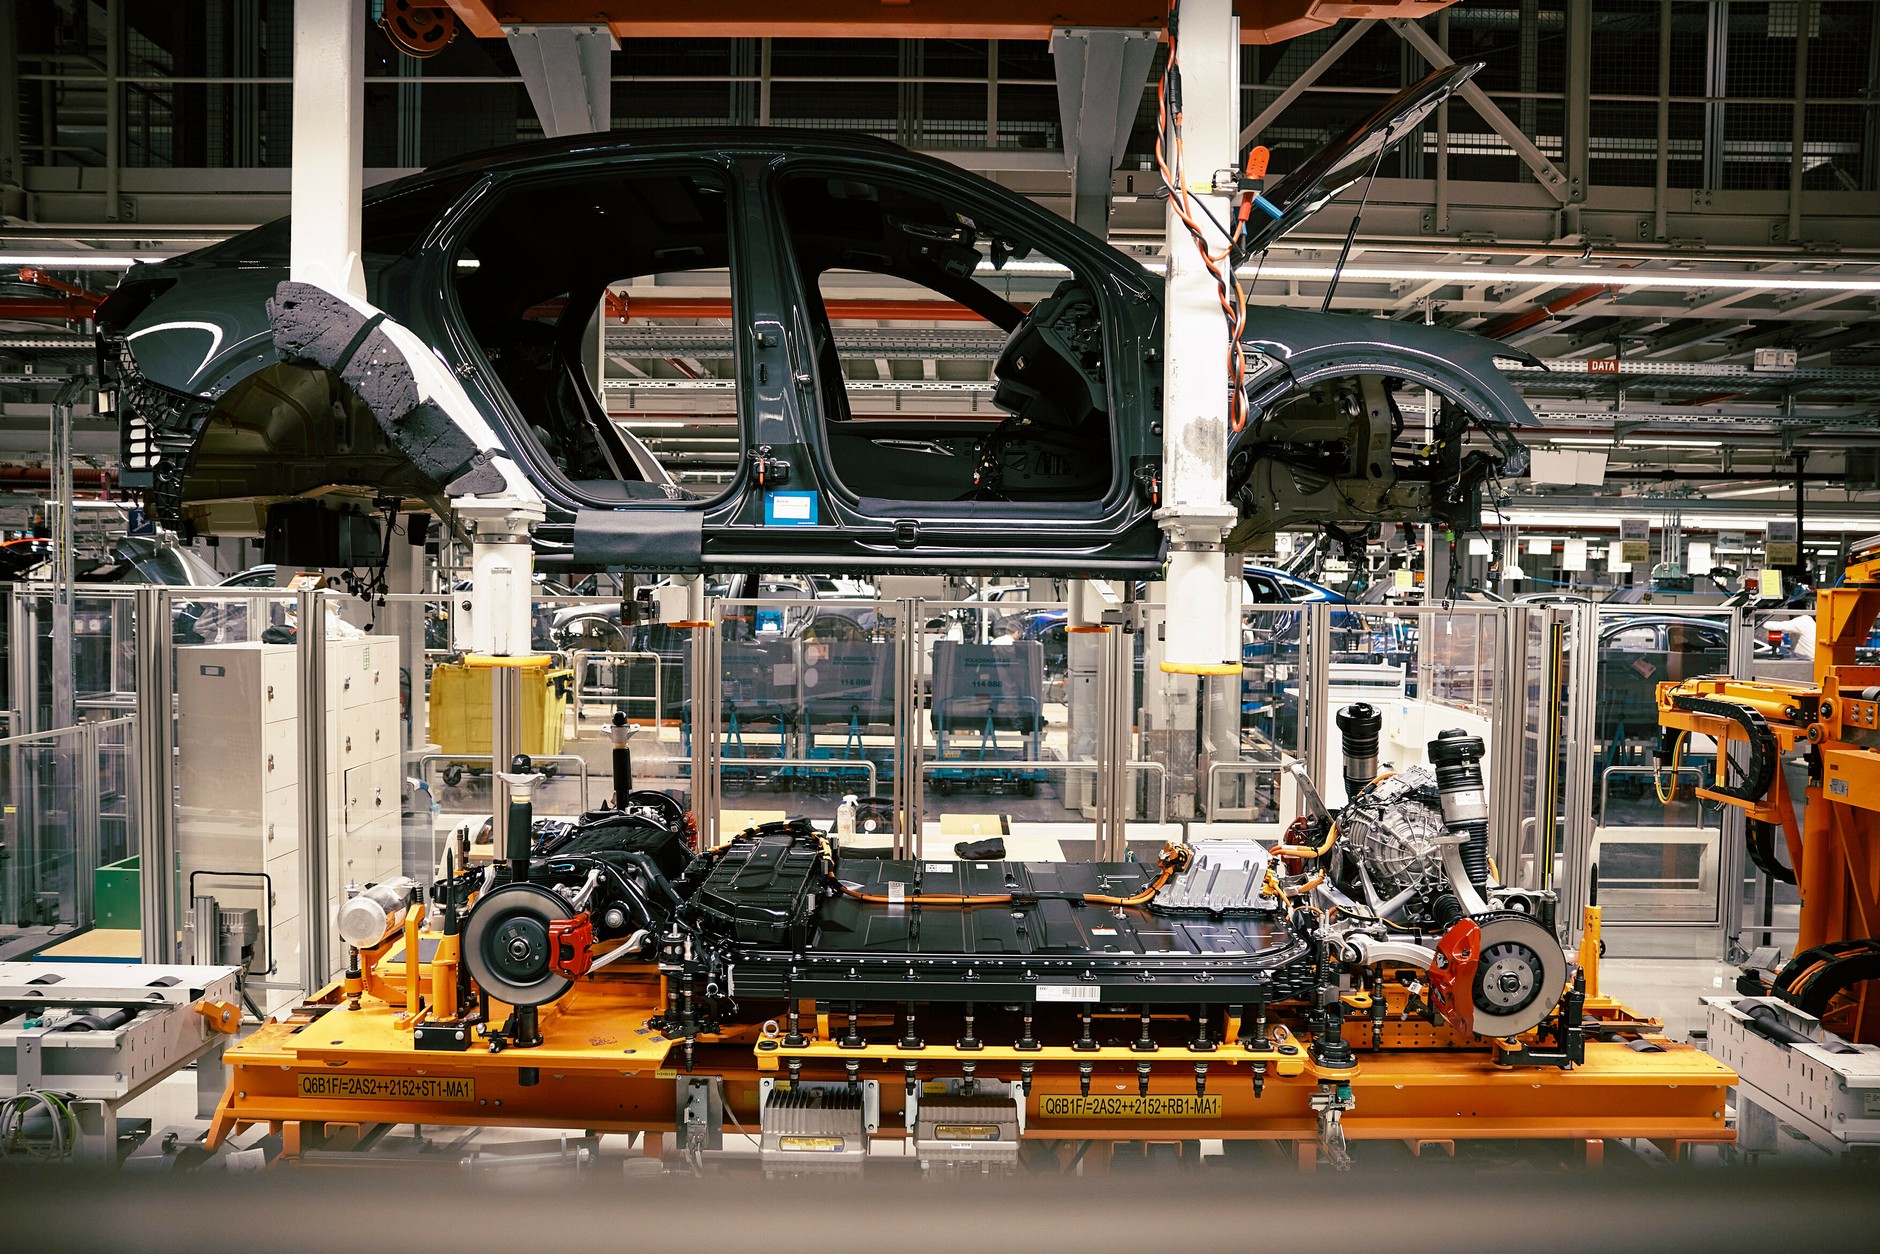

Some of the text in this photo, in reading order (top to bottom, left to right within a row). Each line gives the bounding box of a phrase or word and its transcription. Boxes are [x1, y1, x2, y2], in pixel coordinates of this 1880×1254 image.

[1592, 361, 1615, 371] DATA
[302, 1076, 470, 1098] Q6B1F/=2AS2++2152+ST1-MA1
[1045, 1097, 1218, 1116] Q6B1F/=2AS2++2152+RB1-MA1
